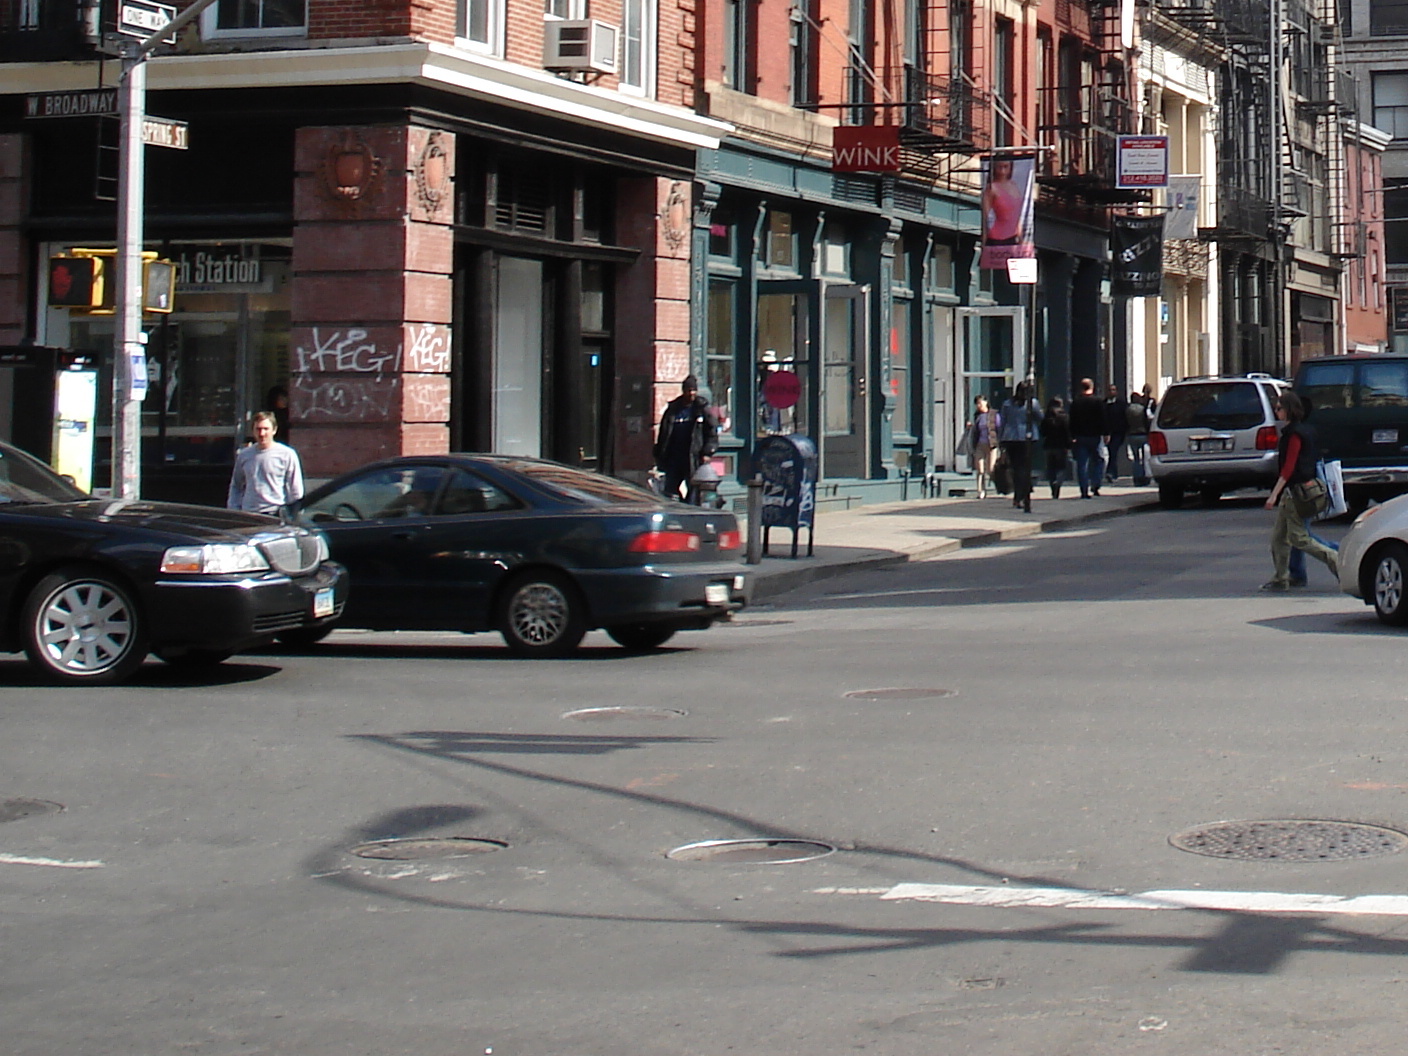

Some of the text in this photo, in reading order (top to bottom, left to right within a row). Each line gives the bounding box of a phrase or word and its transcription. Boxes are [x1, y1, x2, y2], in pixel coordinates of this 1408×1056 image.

[127, 9, 144, 25] ONE
[27, 93, 115, 116] W BROADWAY
[142, 121, 188, 147] SPRING ST
[195, 252, 259, 283] Station
